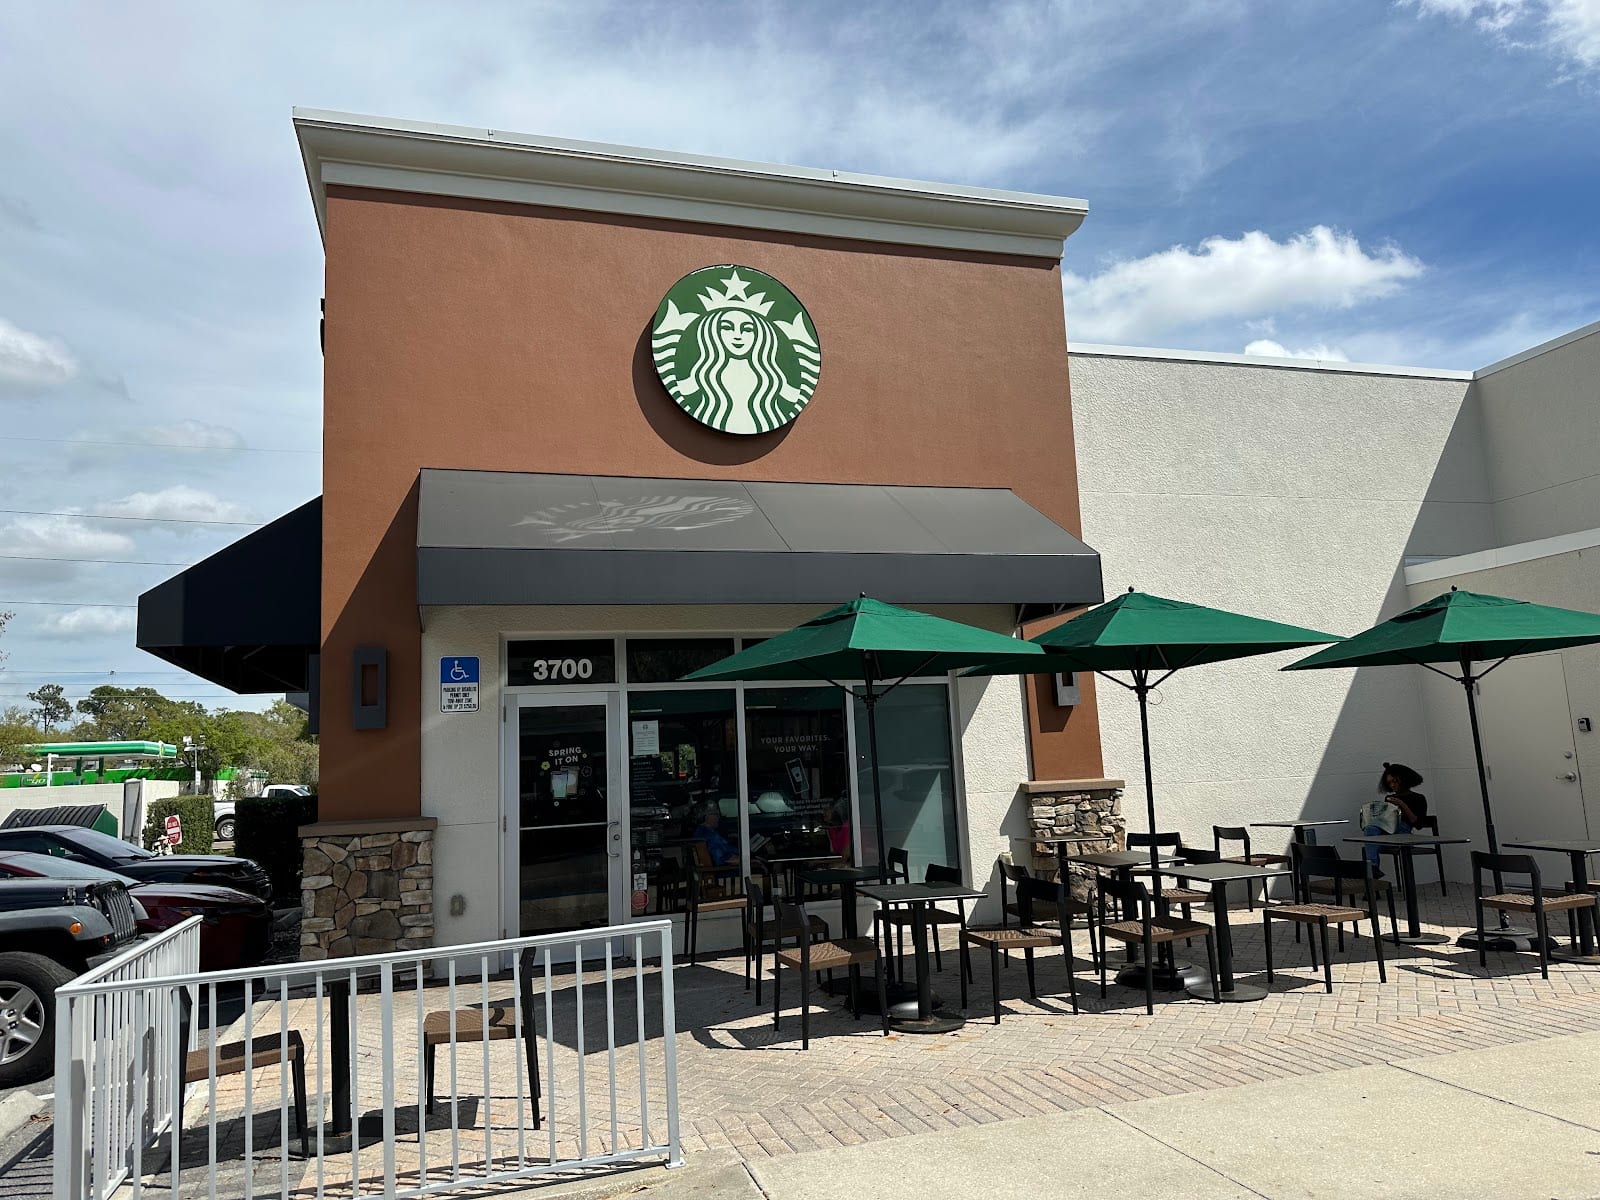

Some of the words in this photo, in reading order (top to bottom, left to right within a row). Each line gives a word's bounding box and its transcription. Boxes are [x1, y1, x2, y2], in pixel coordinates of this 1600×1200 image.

[533, 658, 593, 680] 3700
[760, 736, 783, 744] YOUR
[785, 734, 831, 743] FAVORITES.
[548, 746, 582, 757] SPRING
[774, 745, 796, 753] YOUR
[798, 744, 818, 752] WAY.
[554, 757, 563, 766] IT
[565, 755, 579, 764] ON
